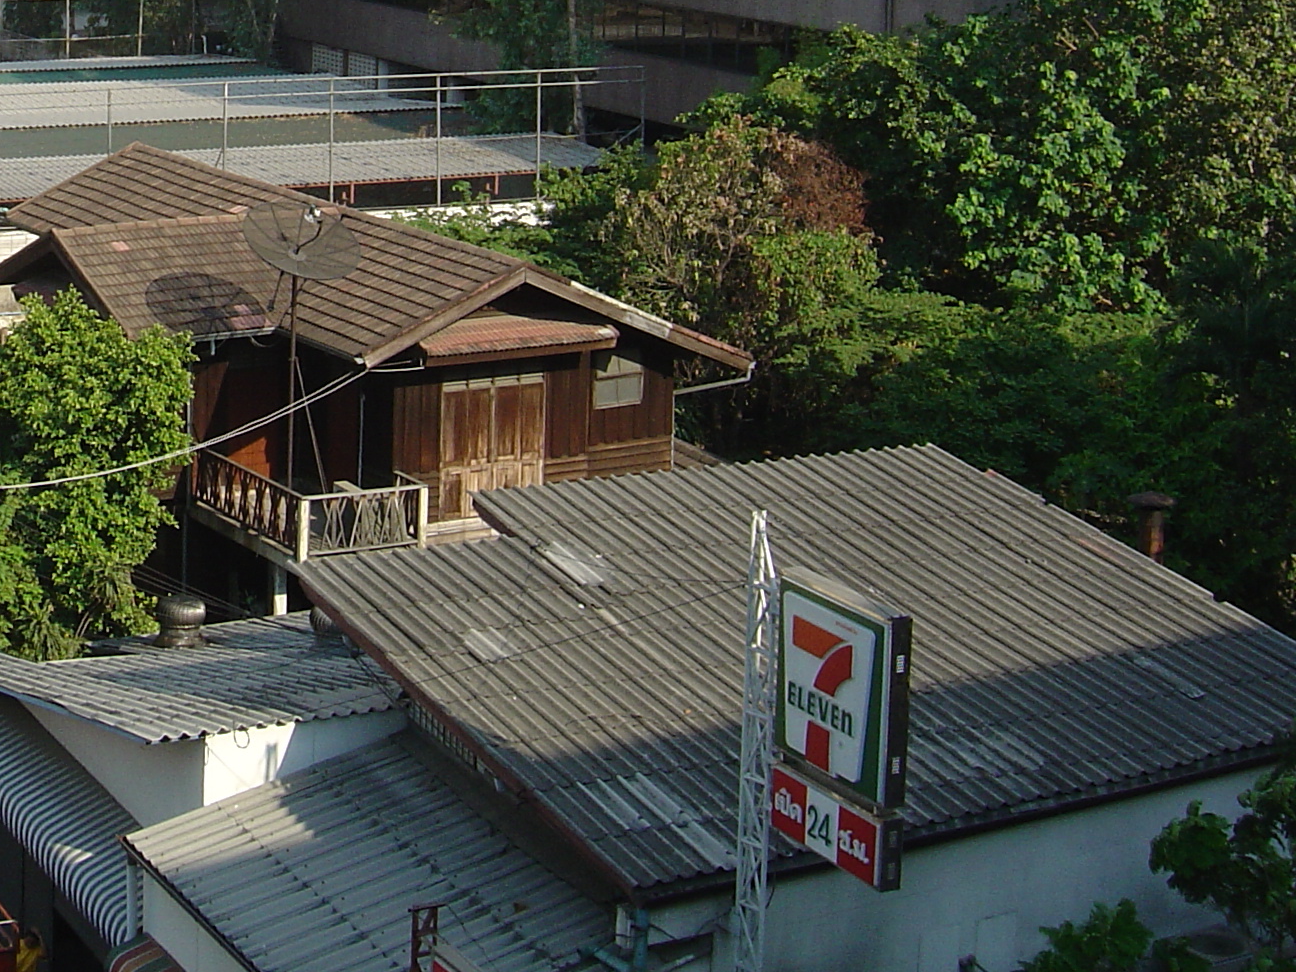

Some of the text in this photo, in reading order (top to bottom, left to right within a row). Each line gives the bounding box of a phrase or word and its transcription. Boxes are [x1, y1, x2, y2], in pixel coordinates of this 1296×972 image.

[791, 614, 854, 776] 7
[774, 787, 803, 824] เปิด
[807, 804, 832, 847] 24
